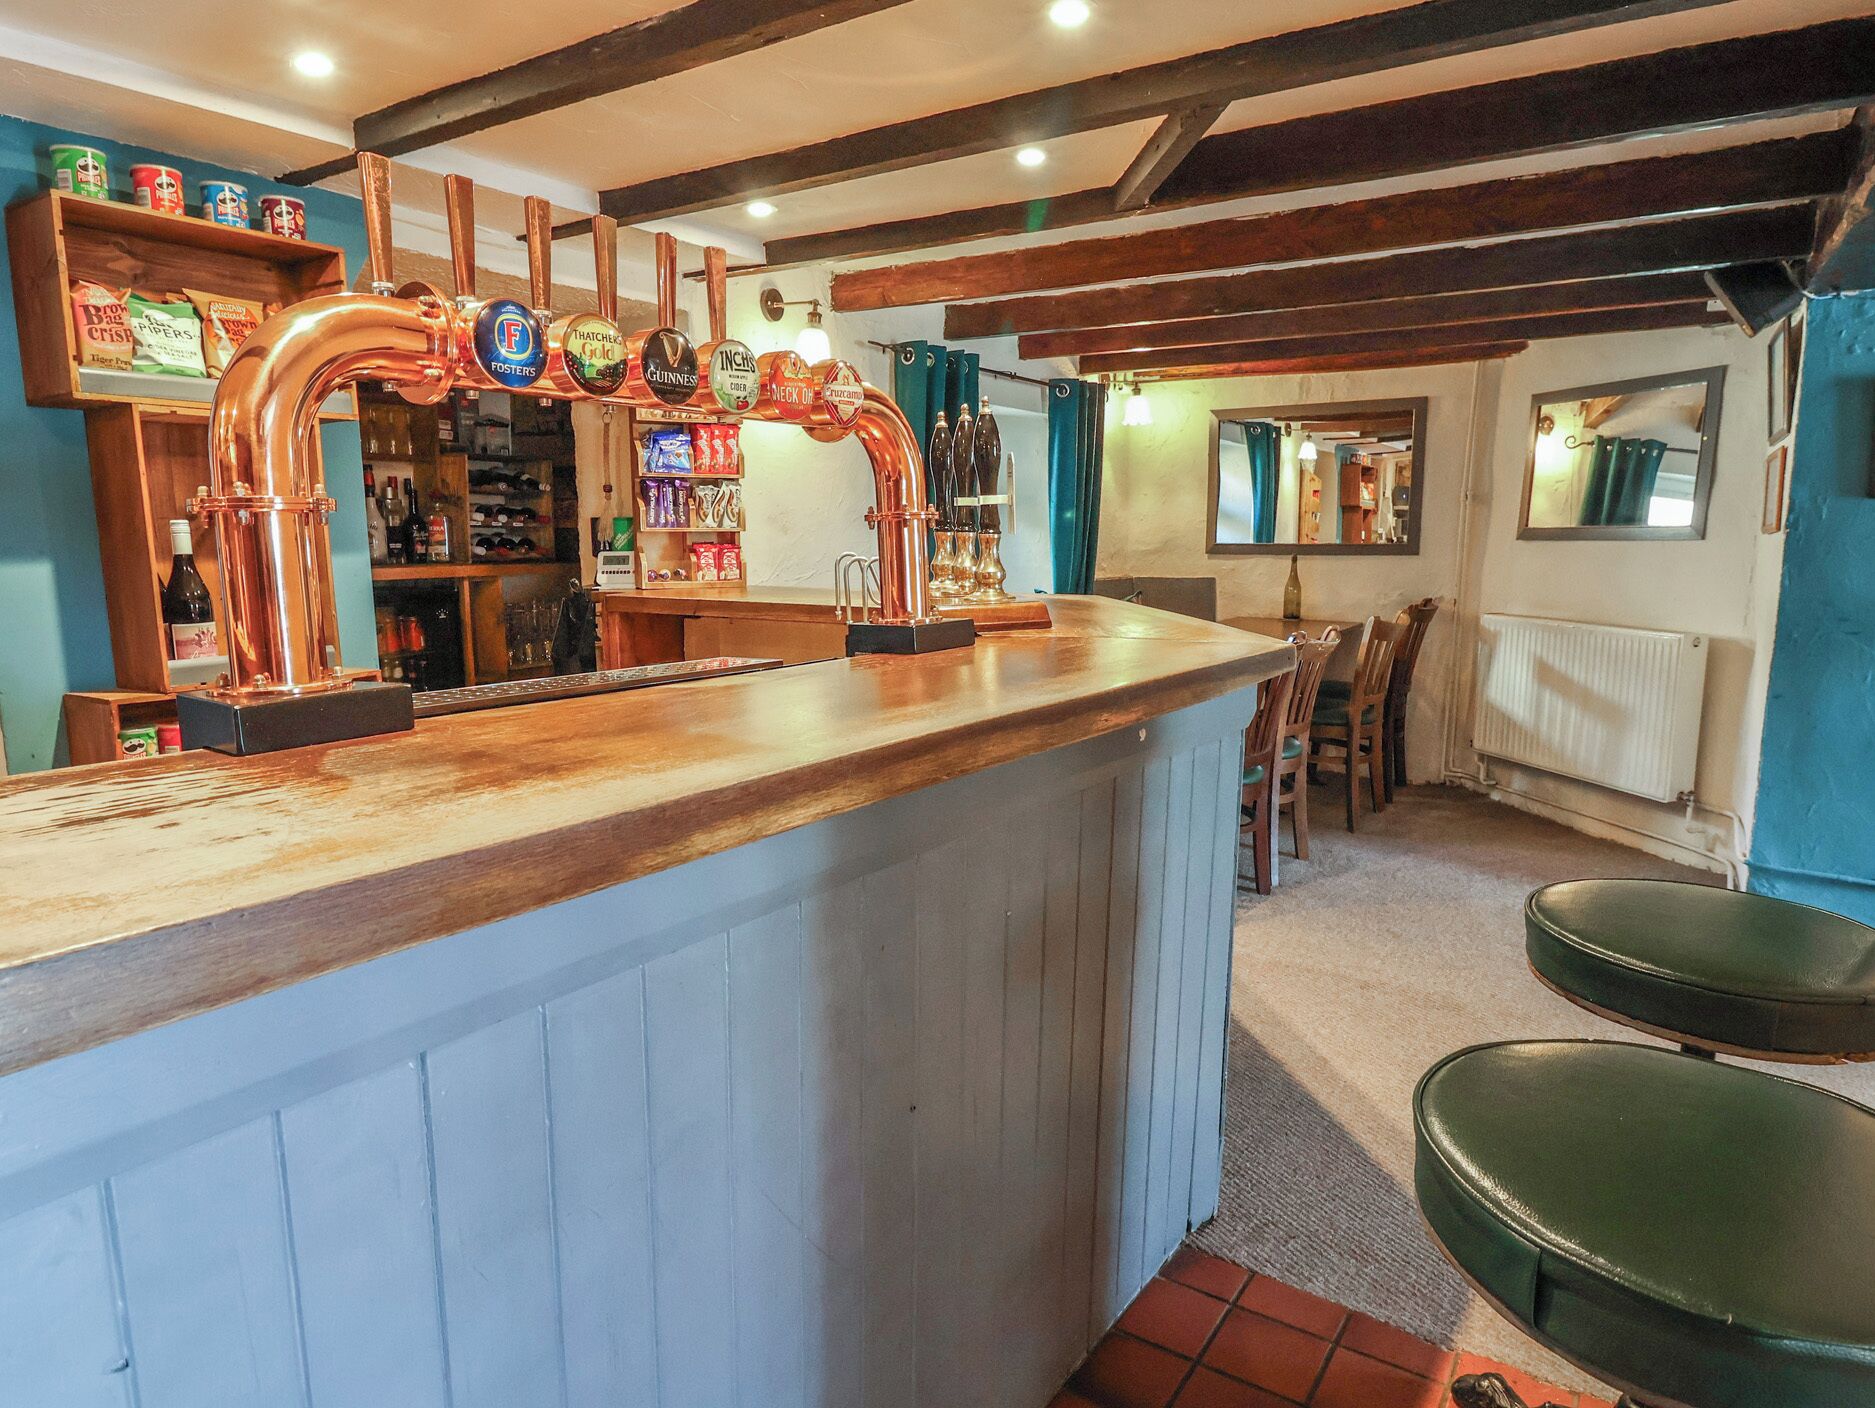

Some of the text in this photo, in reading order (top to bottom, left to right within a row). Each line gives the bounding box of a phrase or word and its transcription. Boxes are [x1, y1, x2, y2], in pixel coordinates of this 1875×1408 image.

[79, 302, 129, 326] Brow
[87, 326, 133, 343] crisp
[138, 323, 194, 341] PIPERS
[503, 320, 523, 352] F
[581, 341, 615, 361] Gold
[491, 361, 537, 377] FOSTER'S
[647, 367, 698, 387] GUINNESS
[730, 382, 746, 392] CIDER
[773, 384, 799, 404] NECK
